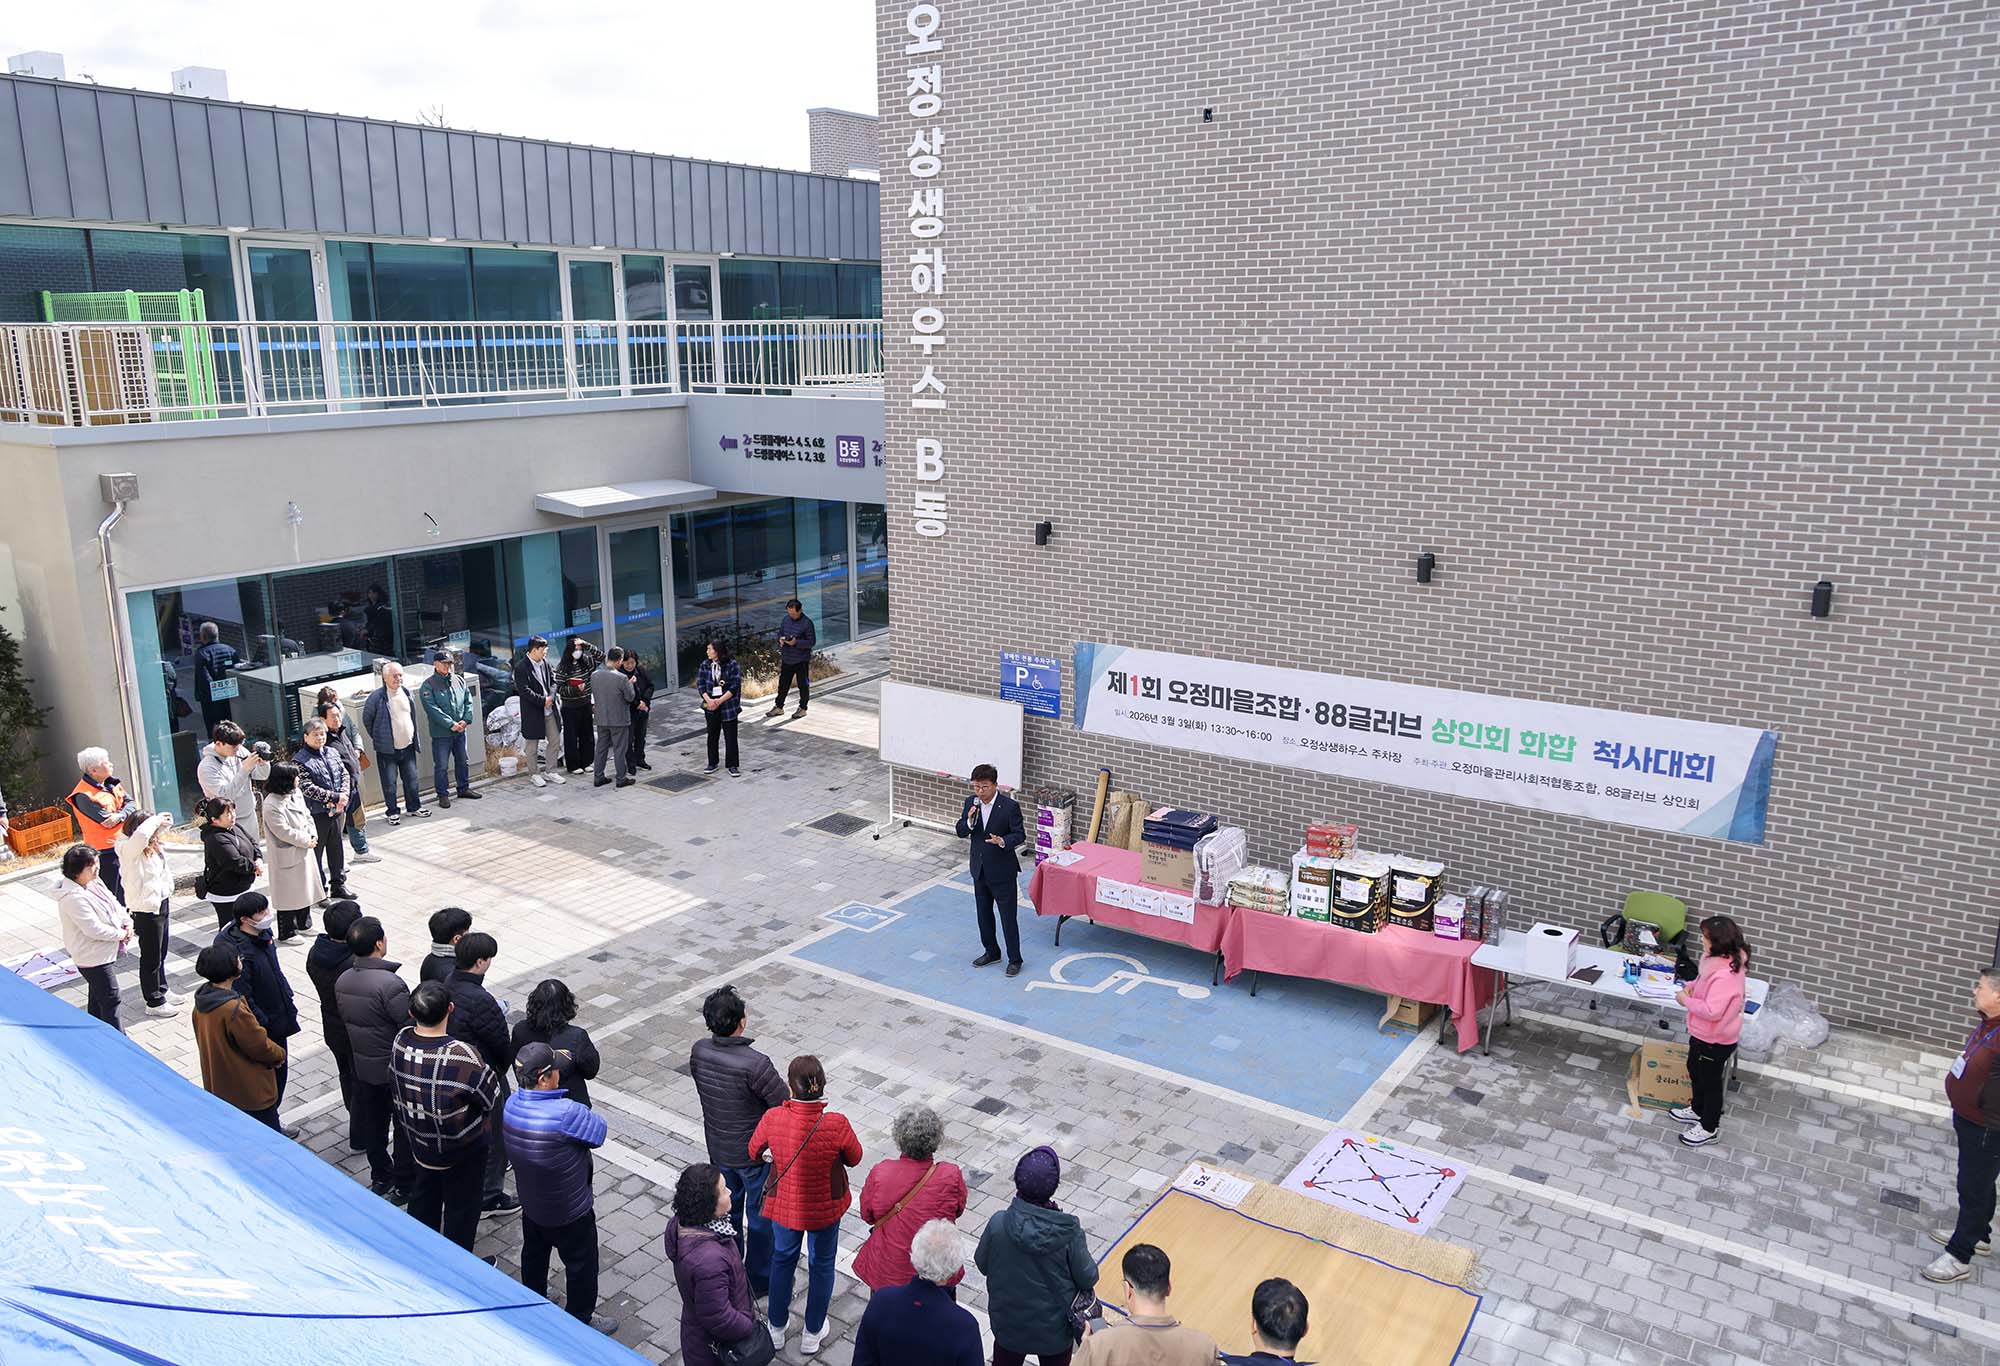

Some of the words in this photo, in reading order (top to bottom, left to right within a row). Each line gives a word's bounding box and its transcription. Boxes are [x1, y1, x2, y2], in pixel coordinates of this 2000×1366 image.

[905, 4, 947, 408] 오정상생하우스
[840, 440, 860, 457] B동
[913, 438, 949, 537] B동
[1016, 666, 1029, 687] P
[1107, 670, 1161, 700] 제1회
[1431, 718, 1510, 753] 상인회
[1518, 730, 1577, 763] 화합
[1593, 740, 1715, 783] 척사대회
[1129, 711, 1158, 724] 2026년
[1161, 716, 1175, 726] 3월
[1178, 719, 1207, 731] 3일(화)
[1211, 724, 1272, 742] 13:30~16:00
[1298, 737, 1368, 757] 오정상생하우스
[1371, 749, 1402, 763] 주차장
[1605, 786, 1657, 803] 88글러브
[1662, 794, 1700, 811] 상인회
